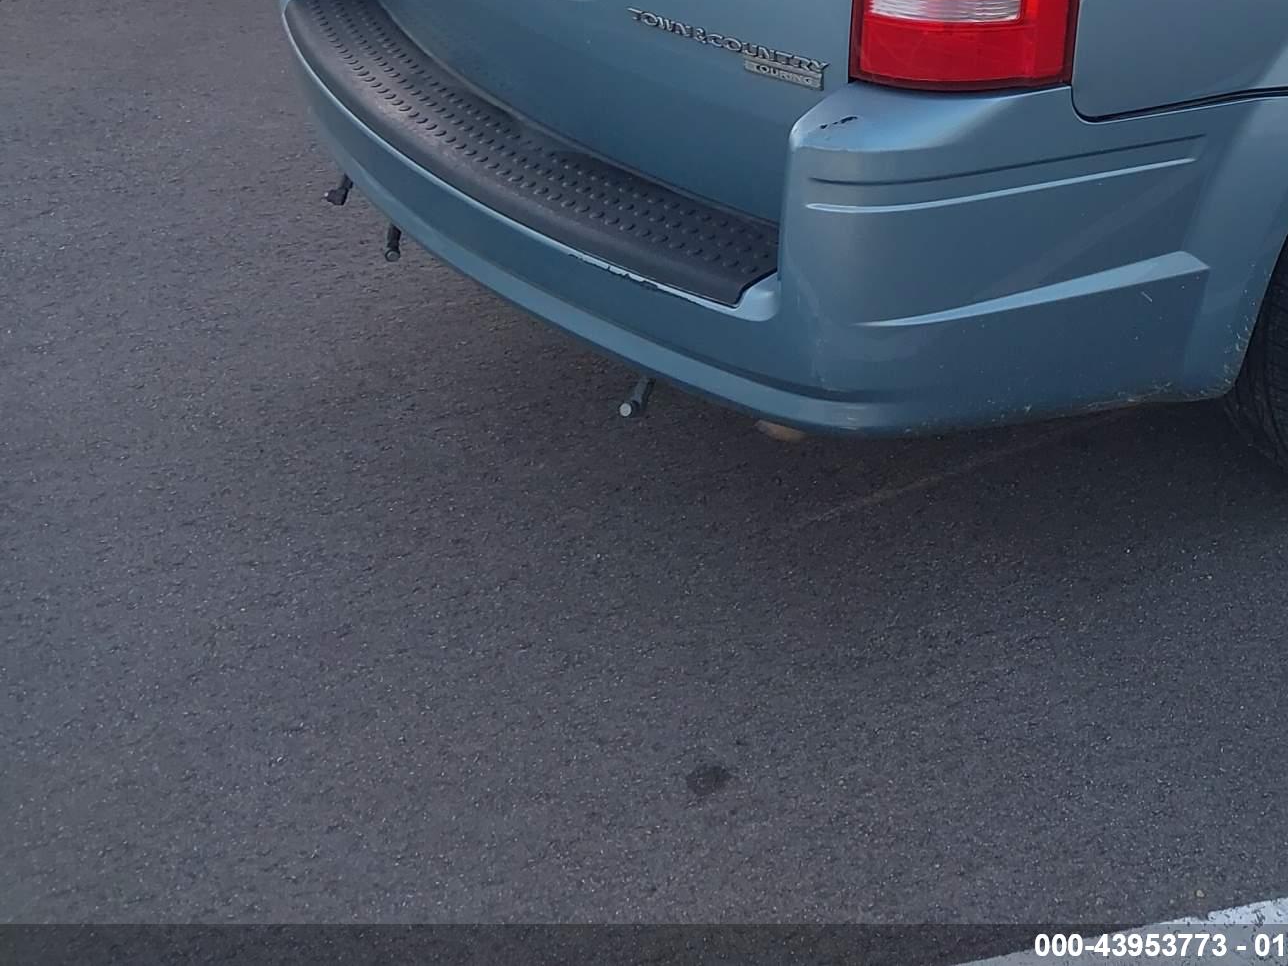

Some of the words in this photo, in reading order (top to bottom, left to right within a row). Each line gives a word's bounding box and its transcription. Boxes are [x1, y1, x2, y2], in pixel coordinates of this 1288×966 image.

[627, 6, 690, 38] TOWN
[706, 33, 830, 72] COUNTRY
[751, 62, 815, 85] TOURING
